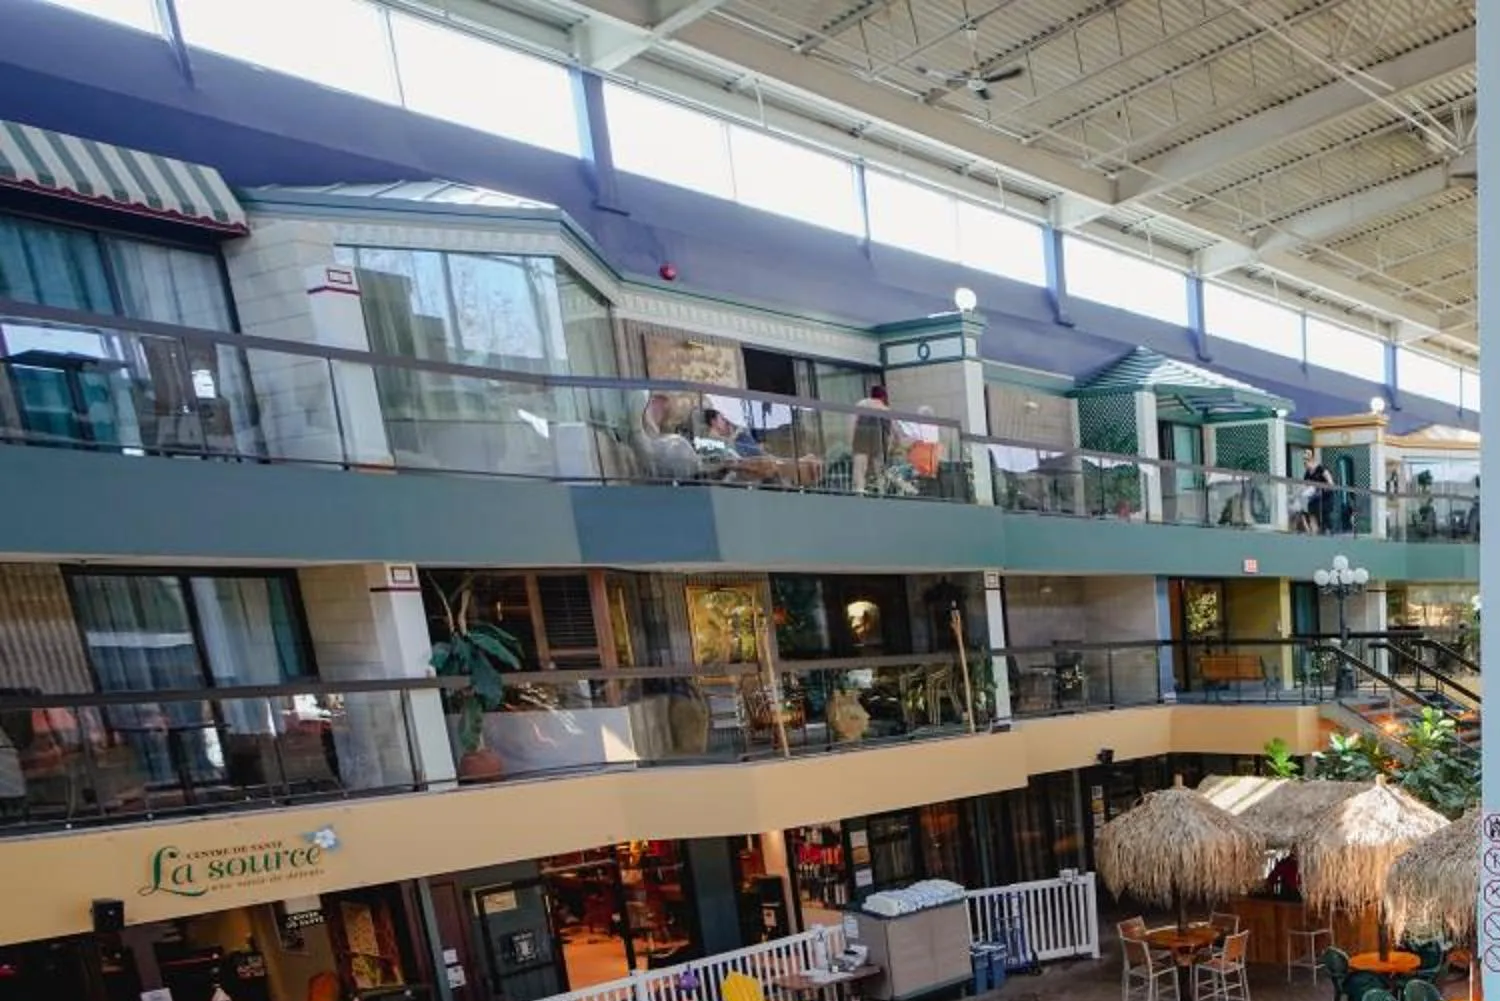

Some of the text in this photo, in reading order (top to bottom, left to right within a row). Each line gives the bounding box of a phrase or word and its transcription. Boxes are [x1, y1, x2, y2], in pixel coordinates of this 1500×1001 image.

[232, 846, 247, 854] DE
[138, 845, 321, 896] La source
